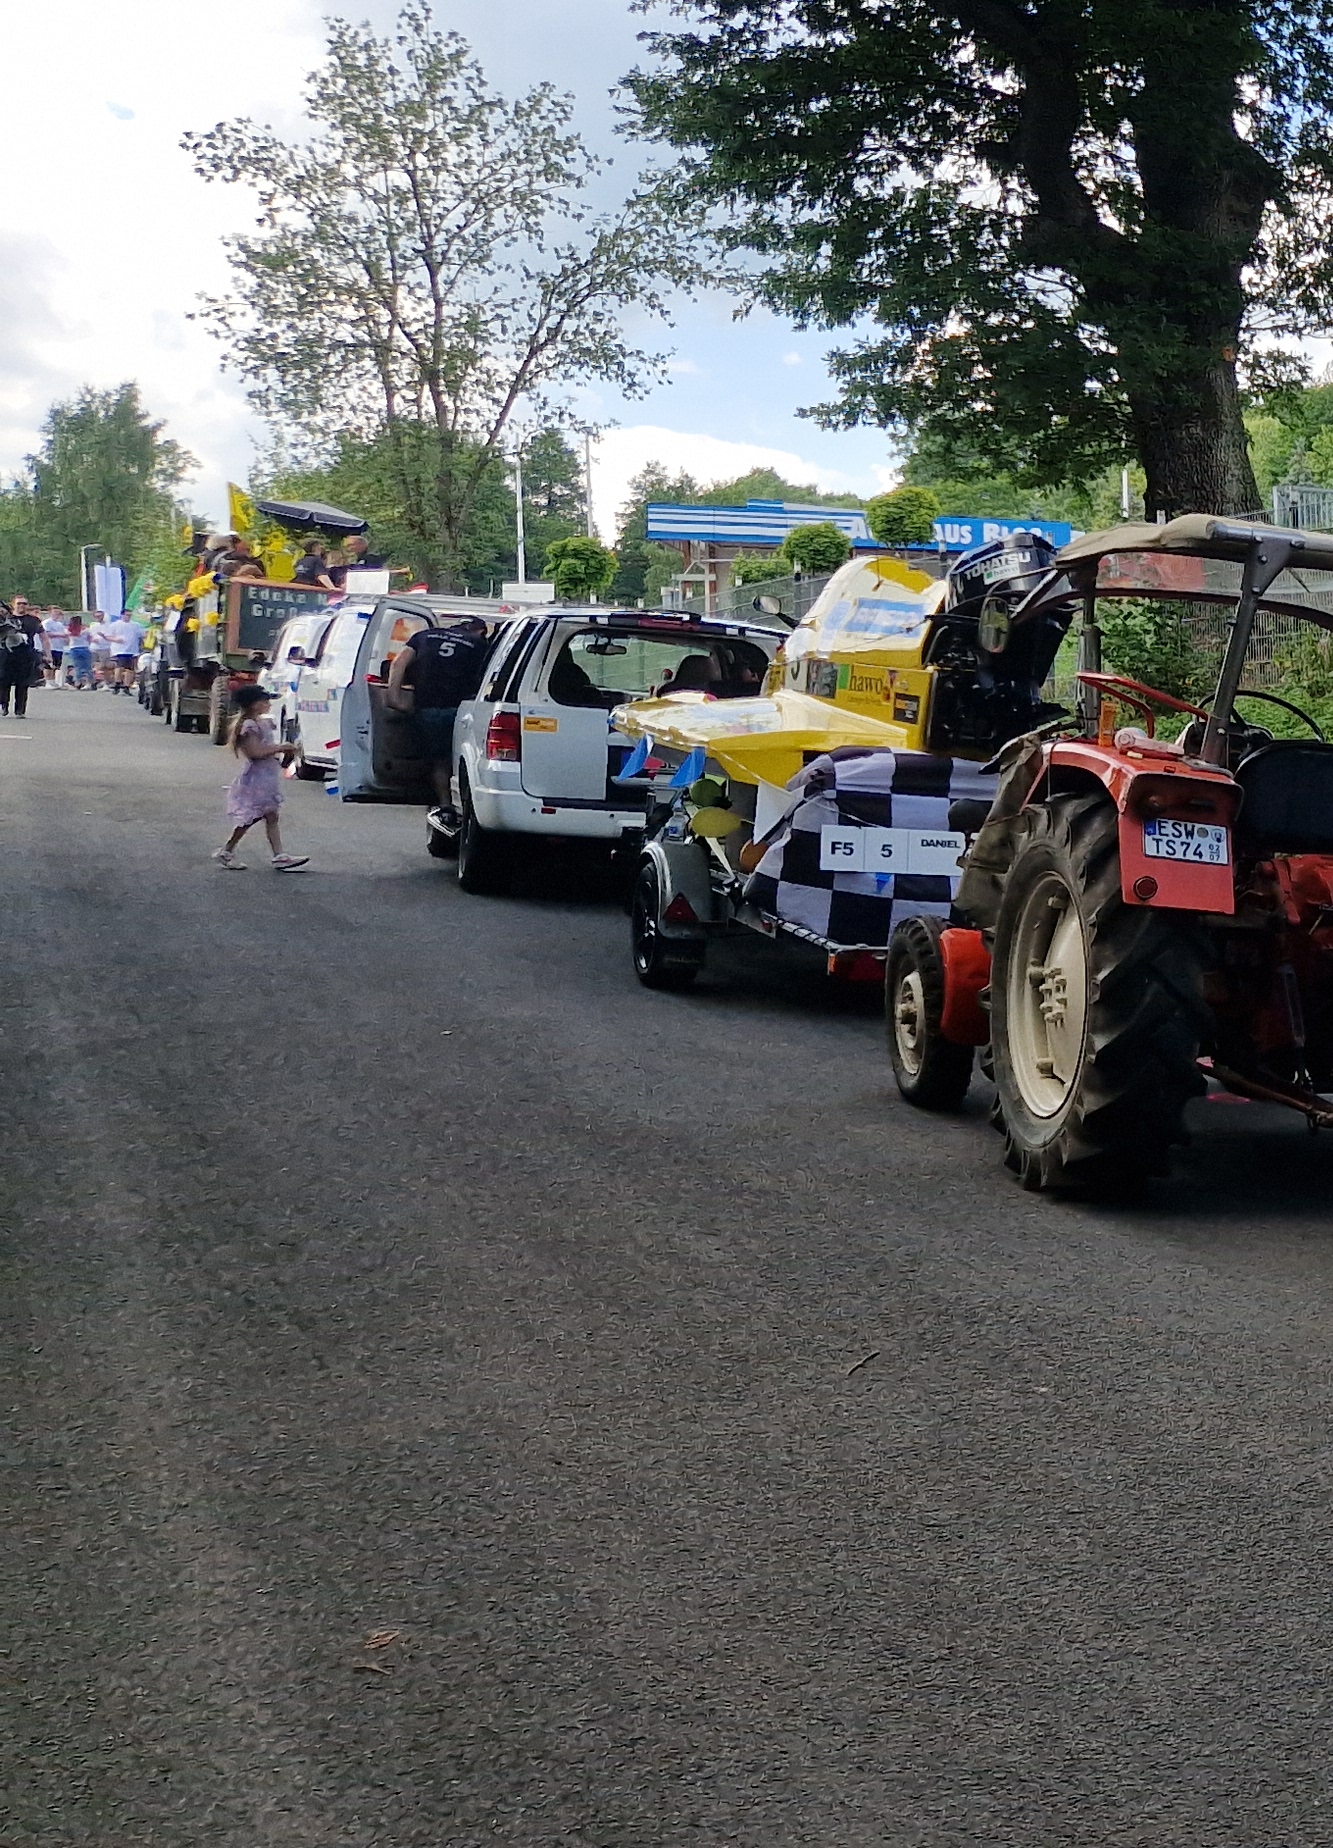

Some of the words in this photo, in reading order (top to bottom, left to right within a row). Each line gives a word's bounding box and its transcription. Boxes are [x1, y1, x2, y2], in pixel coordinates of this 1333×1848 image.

[964, 552, 1031, 580] TOHATSU
[438, 641, 457, 657] 5
[1157, 820, 1196, 840] ESW
[830, 841, 855, 856] F5
[880, 844, 893, 858] 5
[920, 838, 961, 849] DANIEL
